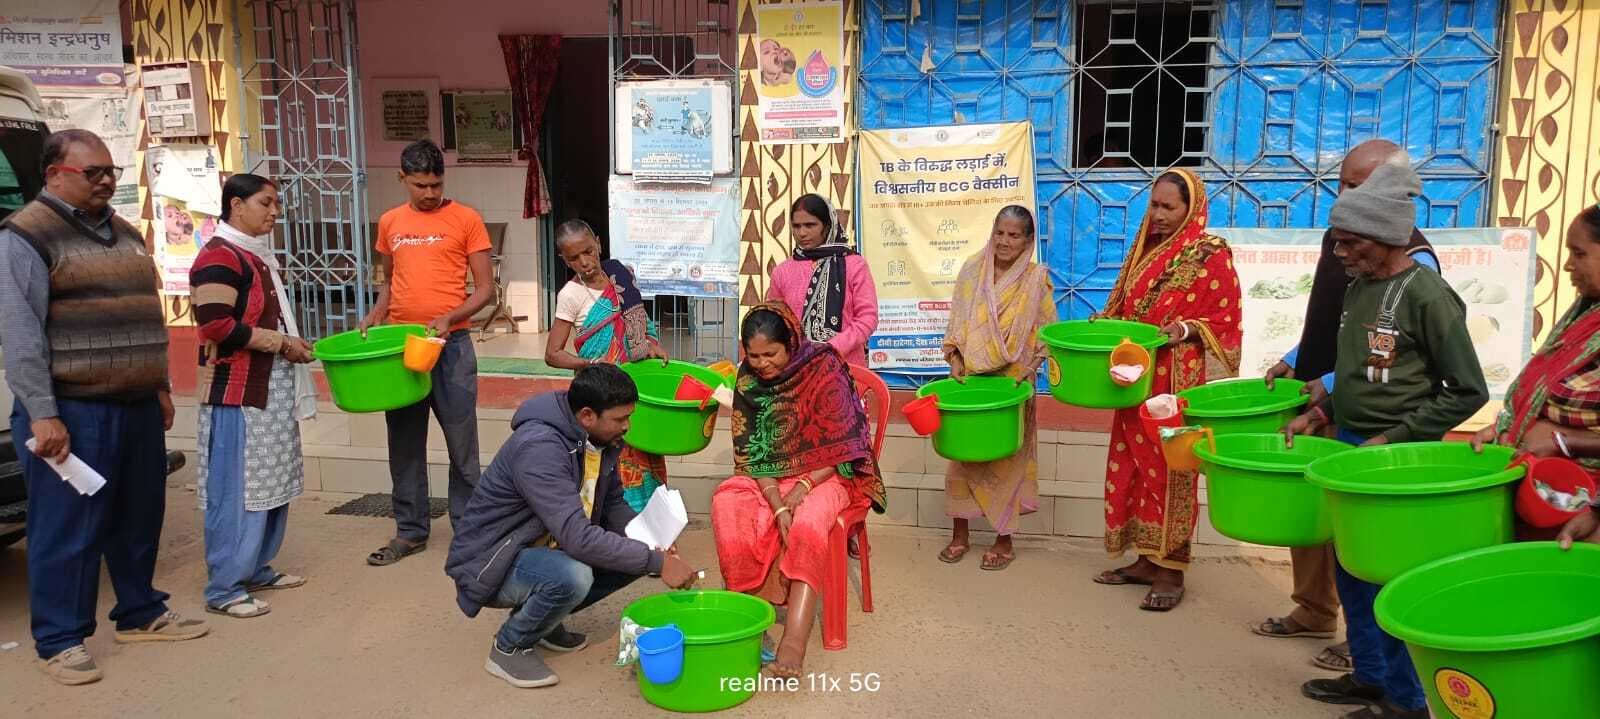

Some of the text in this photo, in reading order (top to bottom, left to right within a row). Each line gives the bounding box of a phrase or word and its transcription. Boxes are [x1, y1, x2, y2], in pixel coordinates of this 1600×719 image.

[0, 27, 111, 51] मिशन इन्द्रधनुष
[897, 159, 911, 172] के
[915, 157, 953, 172] विरुद्ध
[955, 154, 992, 173] लड़ाई
[874, 174, 1020, 195] विश्वसनीय BCG वैक्सीन
